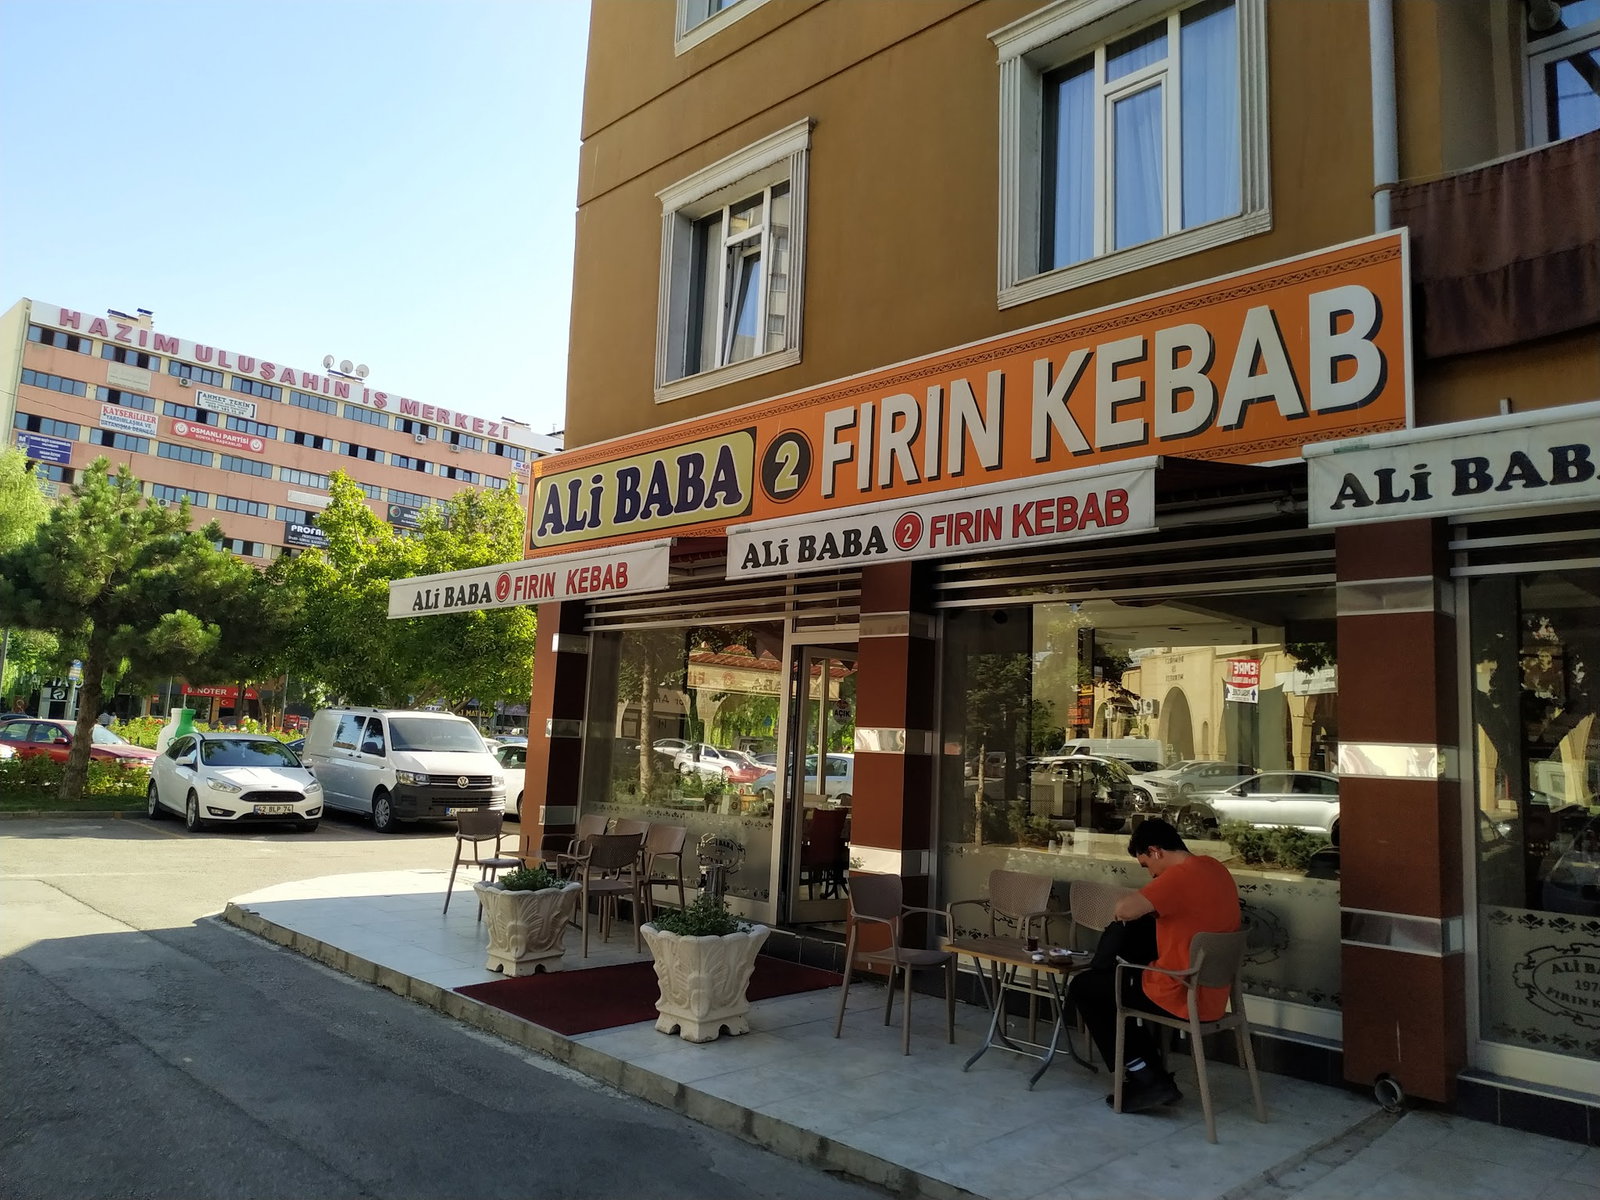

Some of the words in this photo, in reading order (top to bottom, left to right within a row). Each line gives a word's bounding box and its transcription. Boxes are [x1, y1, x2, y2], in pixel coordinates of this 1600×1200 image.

[59, 308, 180, 355] HAZIM
[613, 444, 743, 524] BABA
[774, 440, 801, 493] 2
[821, 369, 1006, 500] FIRIN
[1030, 284, 1388, 460] KEBAB
[190, 427, 222, 439] OSMANLI
[1451, 443, 1600, 497] BAB
[798, 525, 888, 564] BABA
[929, 506, 1002, 549] FIRIN
[1012, 488, 1130, 539] KEBAB
[443, 581, 492, 607] BABA
[513, 572, 556, 601] FIRIN
[565, 562, 628, 595] KEBAB
[197, 688, 227, 696] NOTER
